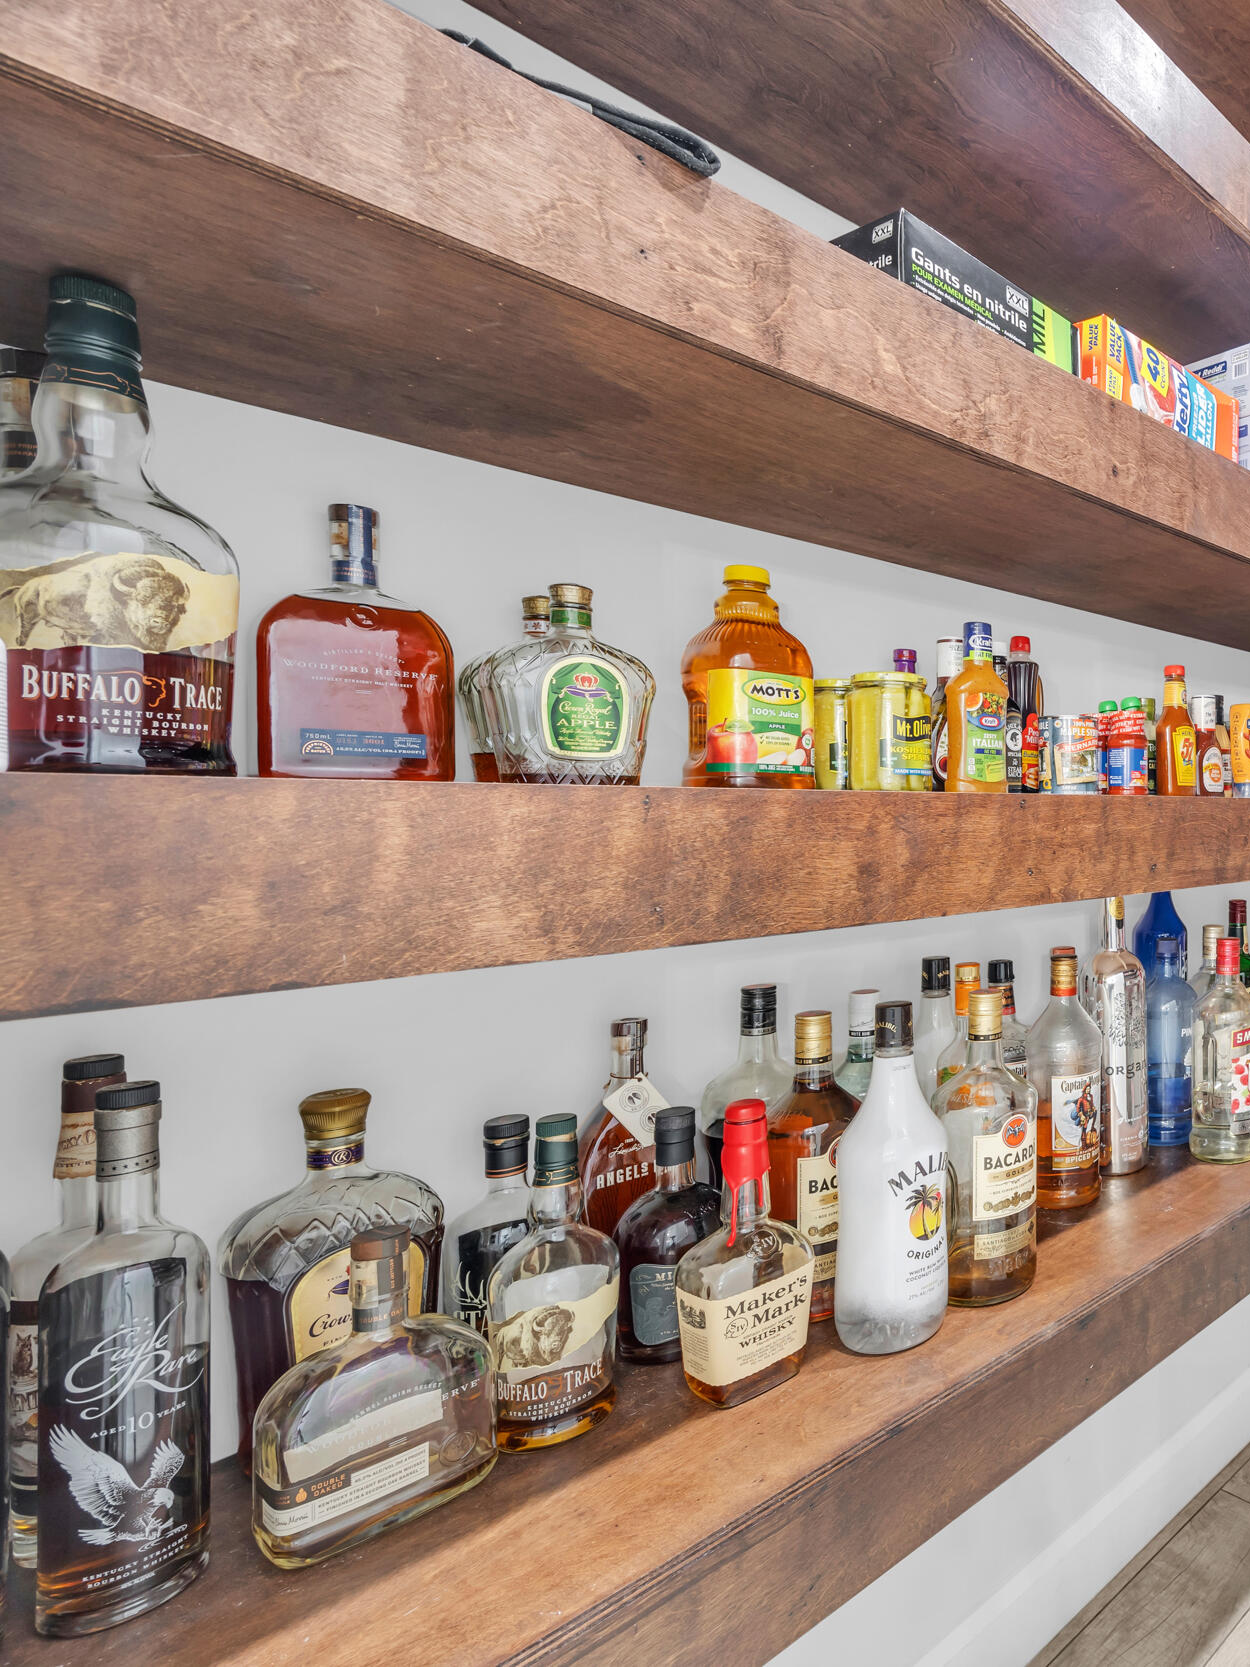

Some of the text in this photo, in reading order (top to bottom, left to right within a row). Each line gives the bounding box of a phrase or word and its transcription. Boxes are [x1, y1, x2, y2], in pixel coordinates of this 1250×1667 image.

[873, 224, 893, 239] XXL
[911, 247, 1027, 333] Gants en nitrile
[912, 264, 994, 320] POUR EXAMEN MÉDICAL
[1008, 291, 1028, 310] XXL
[1146, 347, 1160, 382] 40
[282, 657, 438, 682] WOODFORD RESERVE
[22, 664, 224, 711] BUFFALO TRACE
[56, 714, 210, 731] STRAIGHT BOURBON
[101, 708, 183, 721] KENTUCKY
[557, 718, 617, 730] APPLE
[751, 707, 800, 719] 100% Juice
[107, 726, 178, 737] WHISKEY
[1181, 738, 1194, 761] 57
[596, 1161, 649, 1190] ANGELS
[1005, 1168, 1025, 1178] GOLD
[724, 1275, 807, 1320] Maker's
[751, 1292, 806, 1329] Mark
[309, 1313, 352, 1338] Crow
[739, 1316, 796, 1349] WHISKY
[497, 1357, 603, 1402] BUFFALO TRACE
[90, 1401, 187, 1439] AGED 10 YEARS
[311, 1473, 346, 1491] DOUBLE
[313, 1481, 343, 1497] OAKED
[349, 1481, 377, 1497] STRAIGHT
[81, 1533, 189, 1583] KENTUCKY STRAIGHT
[86, 1544, 186, 1589] BOURBON WHISKEY
